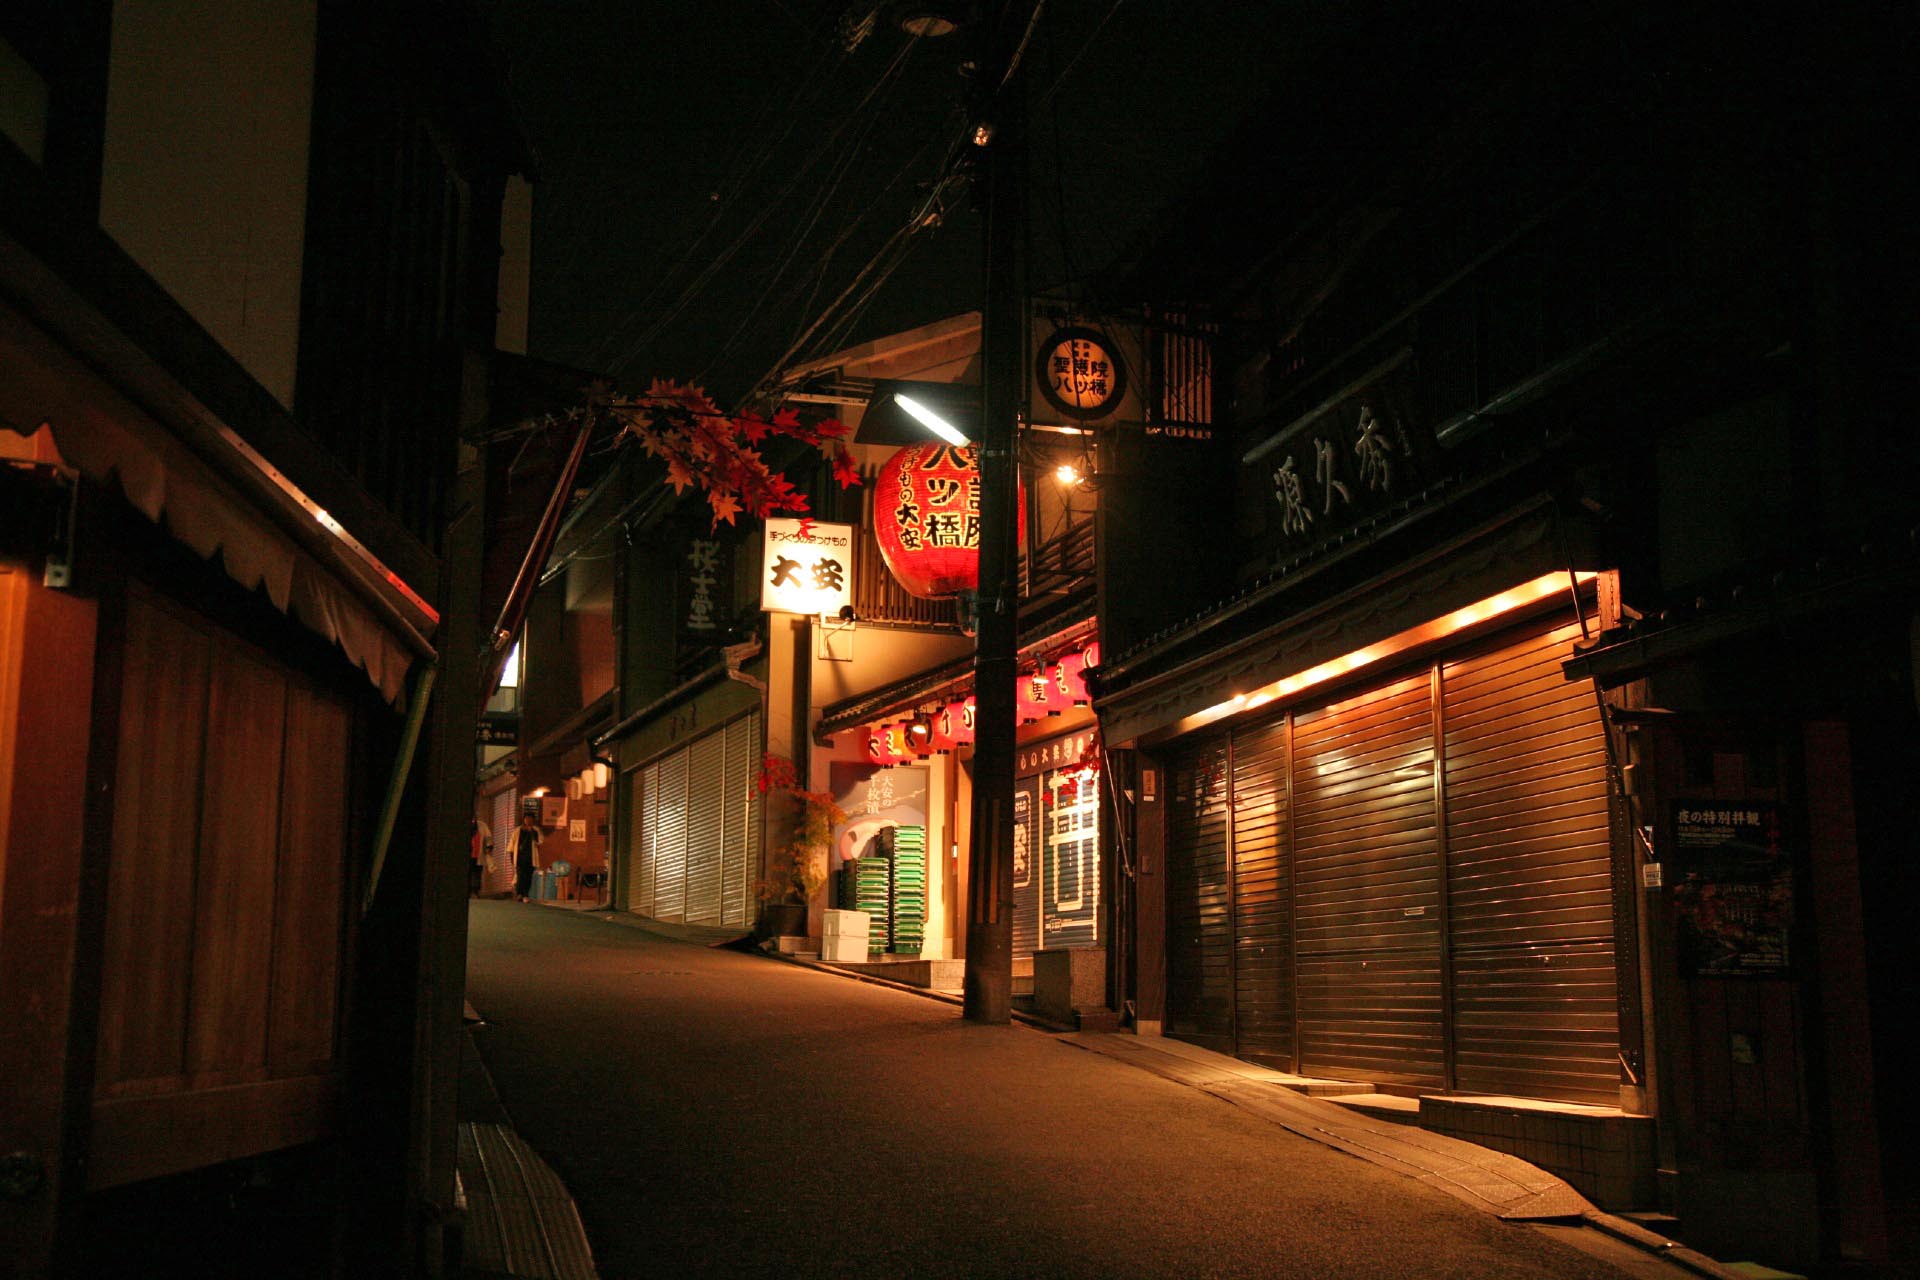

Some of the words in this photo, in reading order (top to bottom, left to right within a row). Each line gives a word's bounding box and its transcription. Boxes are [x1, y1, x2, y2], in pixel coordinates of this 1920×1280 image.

[770, 555, 844, 592] 大安
[1678, 808, 1761, 826] 夜の特別拝観
